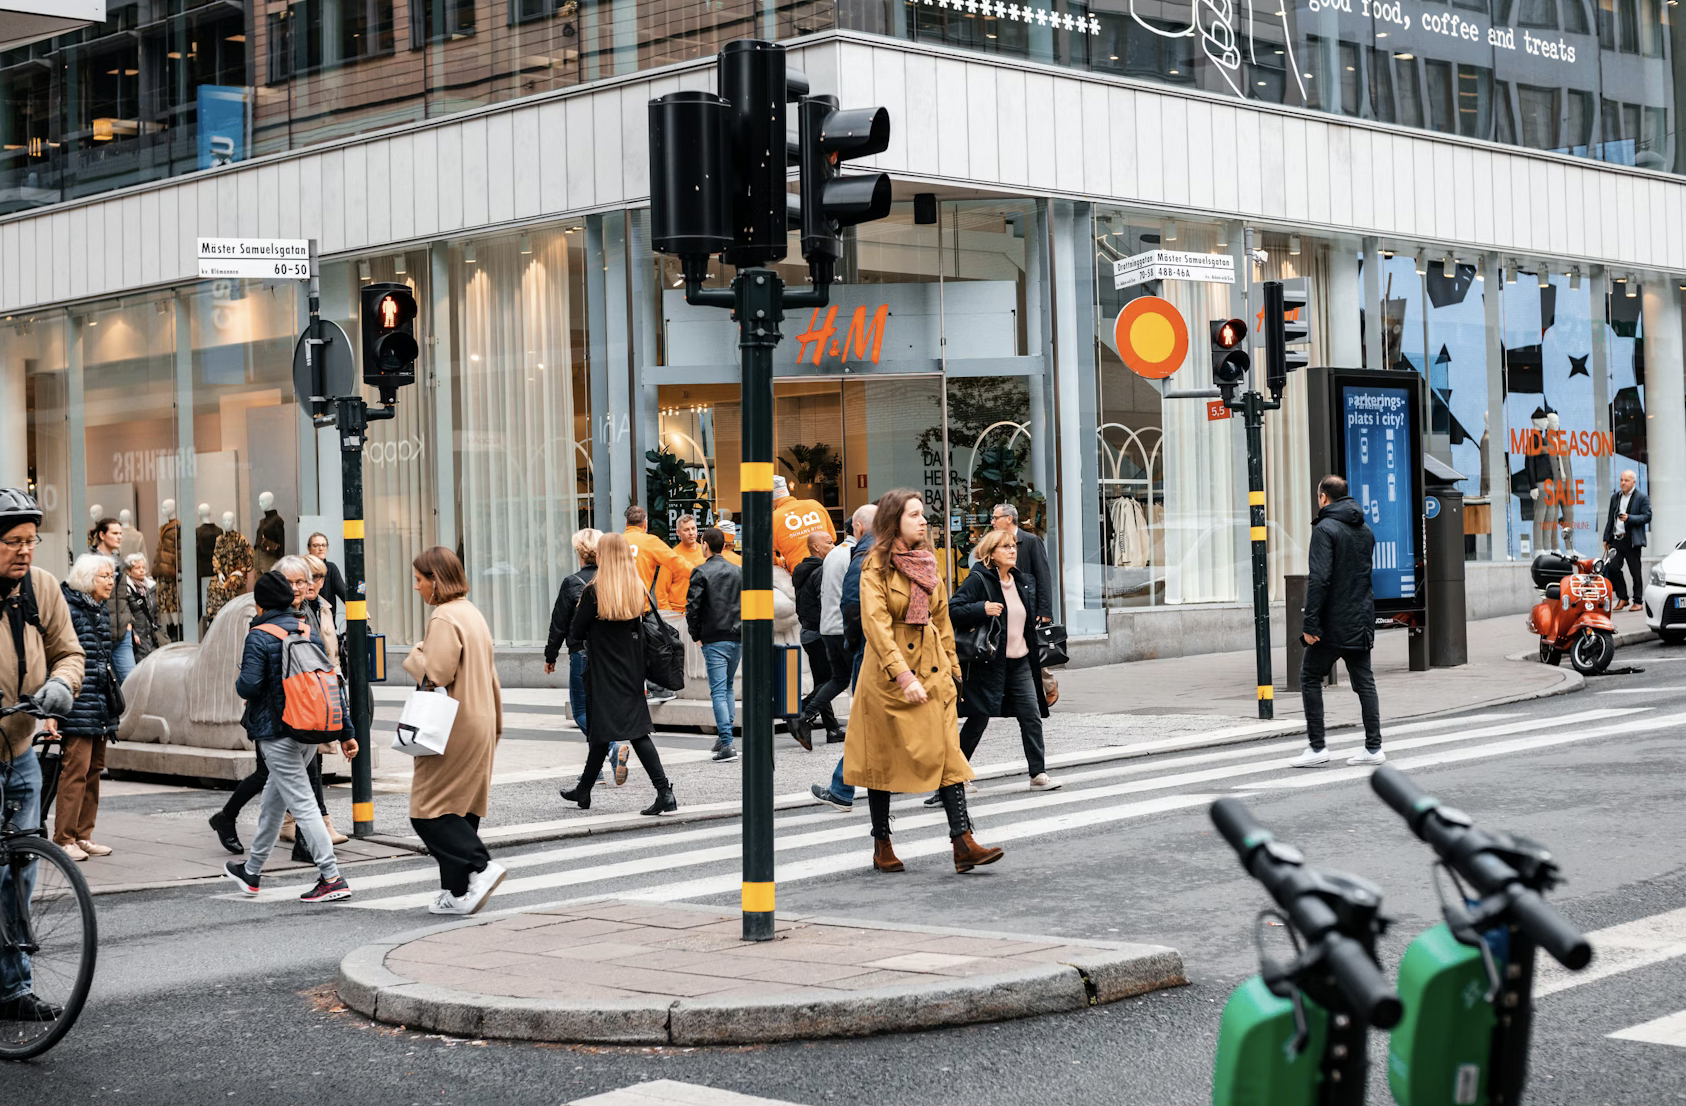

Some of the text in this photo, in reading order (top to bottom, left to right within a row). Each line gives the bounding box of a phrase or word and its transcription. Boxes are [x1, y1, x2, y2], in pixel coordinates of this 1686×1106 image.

[1362, 0, 1411, 30] food,
[1422, 13, 1479, 42] coffee
[1488, 27, 1516, 50] and
[1524, 30, 1576, 63] treats
[201, 242, 306, 258] Mäster Samuelsgatan
[1117, 255, 1154, 272] Drottninggatan
[1157, 253, 1231, 268] Mäster Samuelsgatan
[274, 263, 307, 275] 60-50
[1158, 267, 1191, 278] 48B-46A
[795, 304, 889, 367] H&M
[1211, 406, 1225, 417] 5,5
[1347, 411, 1405, 430] plats i city?
[1510, 428, 1613, 457] MID SEASON
[924, 470, 959, 486] HER
[925, 489, 960, 505] BAN
[1543, 478, 1585, 506] SALE
[1425, 500, 1436, 515] P
